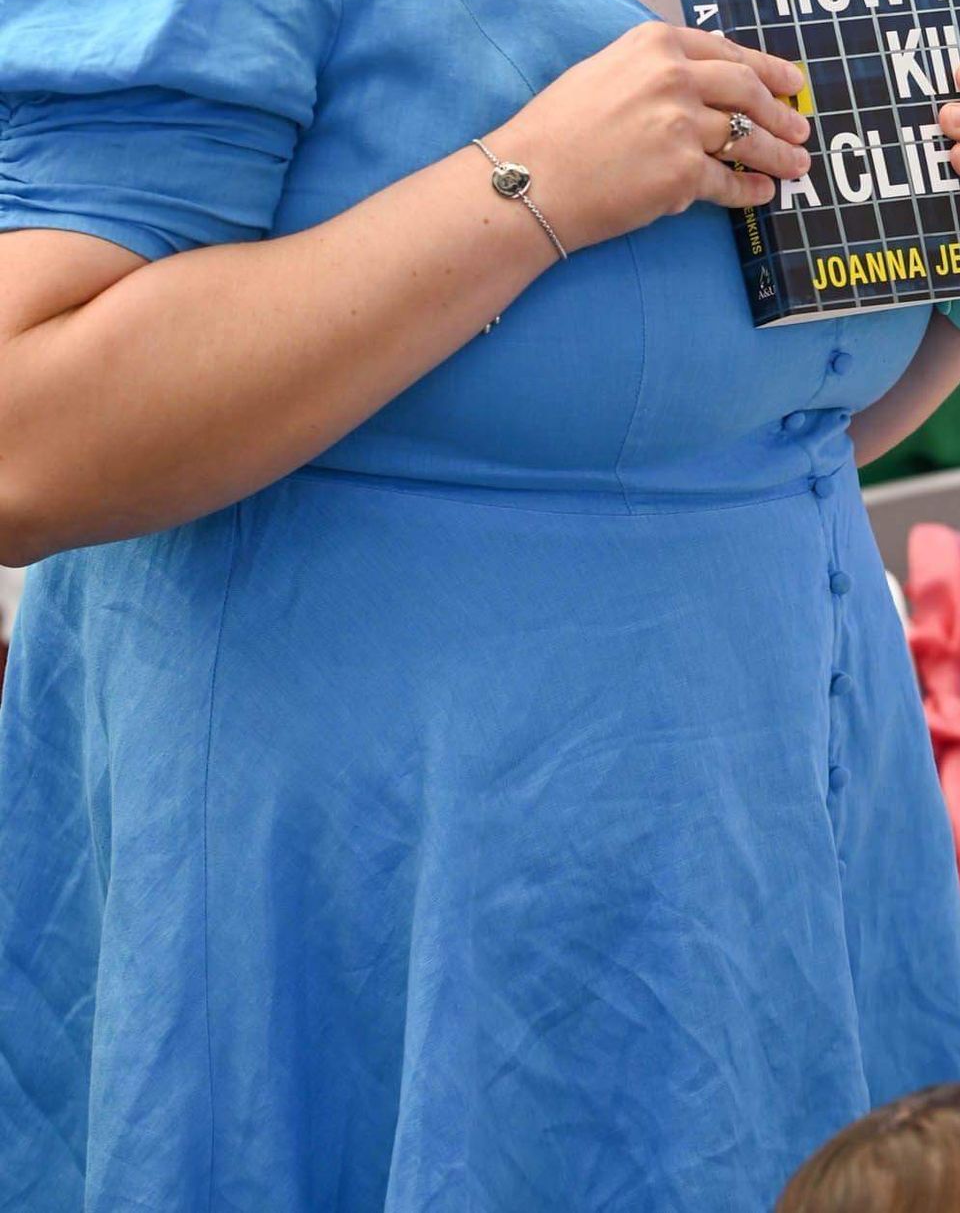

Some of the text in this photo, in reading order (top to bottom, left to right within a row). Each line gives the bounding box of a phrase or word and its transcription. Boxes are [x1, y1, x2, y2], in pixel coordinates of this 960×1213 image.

[693, 3, 719, 25] A
[743, 206, 762, 255] ENKINS
[812, 247, 927, 290] JOANNA
